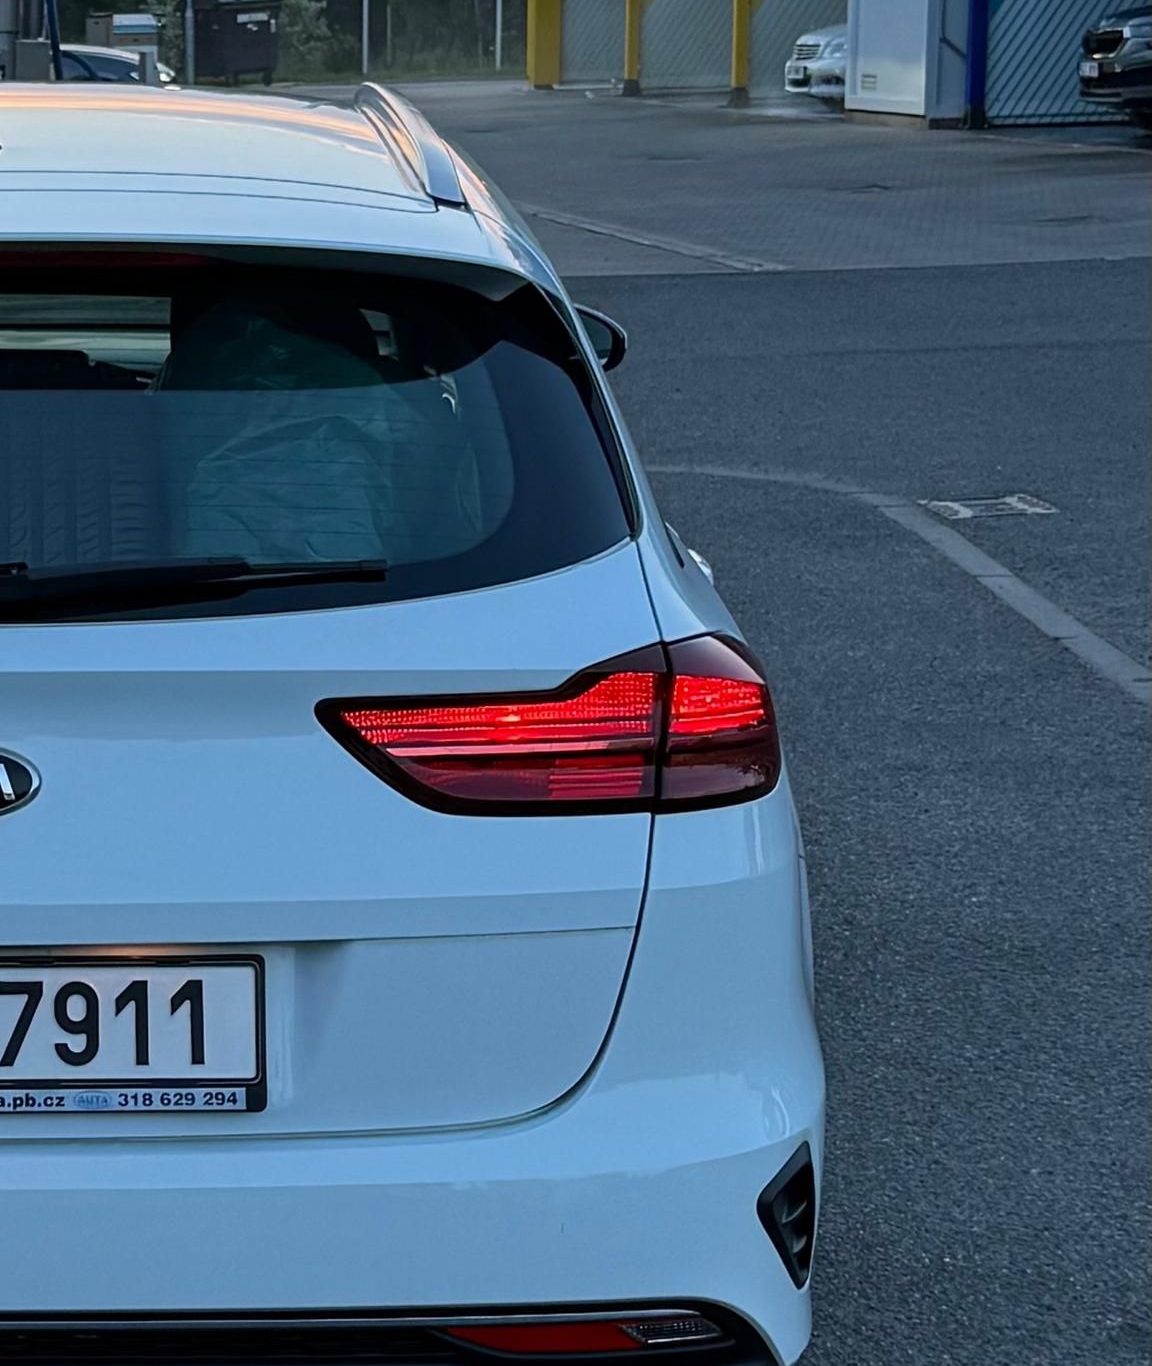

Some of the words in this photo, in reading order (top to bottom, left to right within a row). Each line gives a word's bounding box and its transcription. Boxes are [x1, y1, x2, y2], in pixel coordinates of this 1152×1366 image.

[77, 1093, 109, 1106] AUTA
[117, 1092, 154, 1107] 318
[159, 1091, 196, 1107] 629
[202, 1091, 238, 1106] 294
